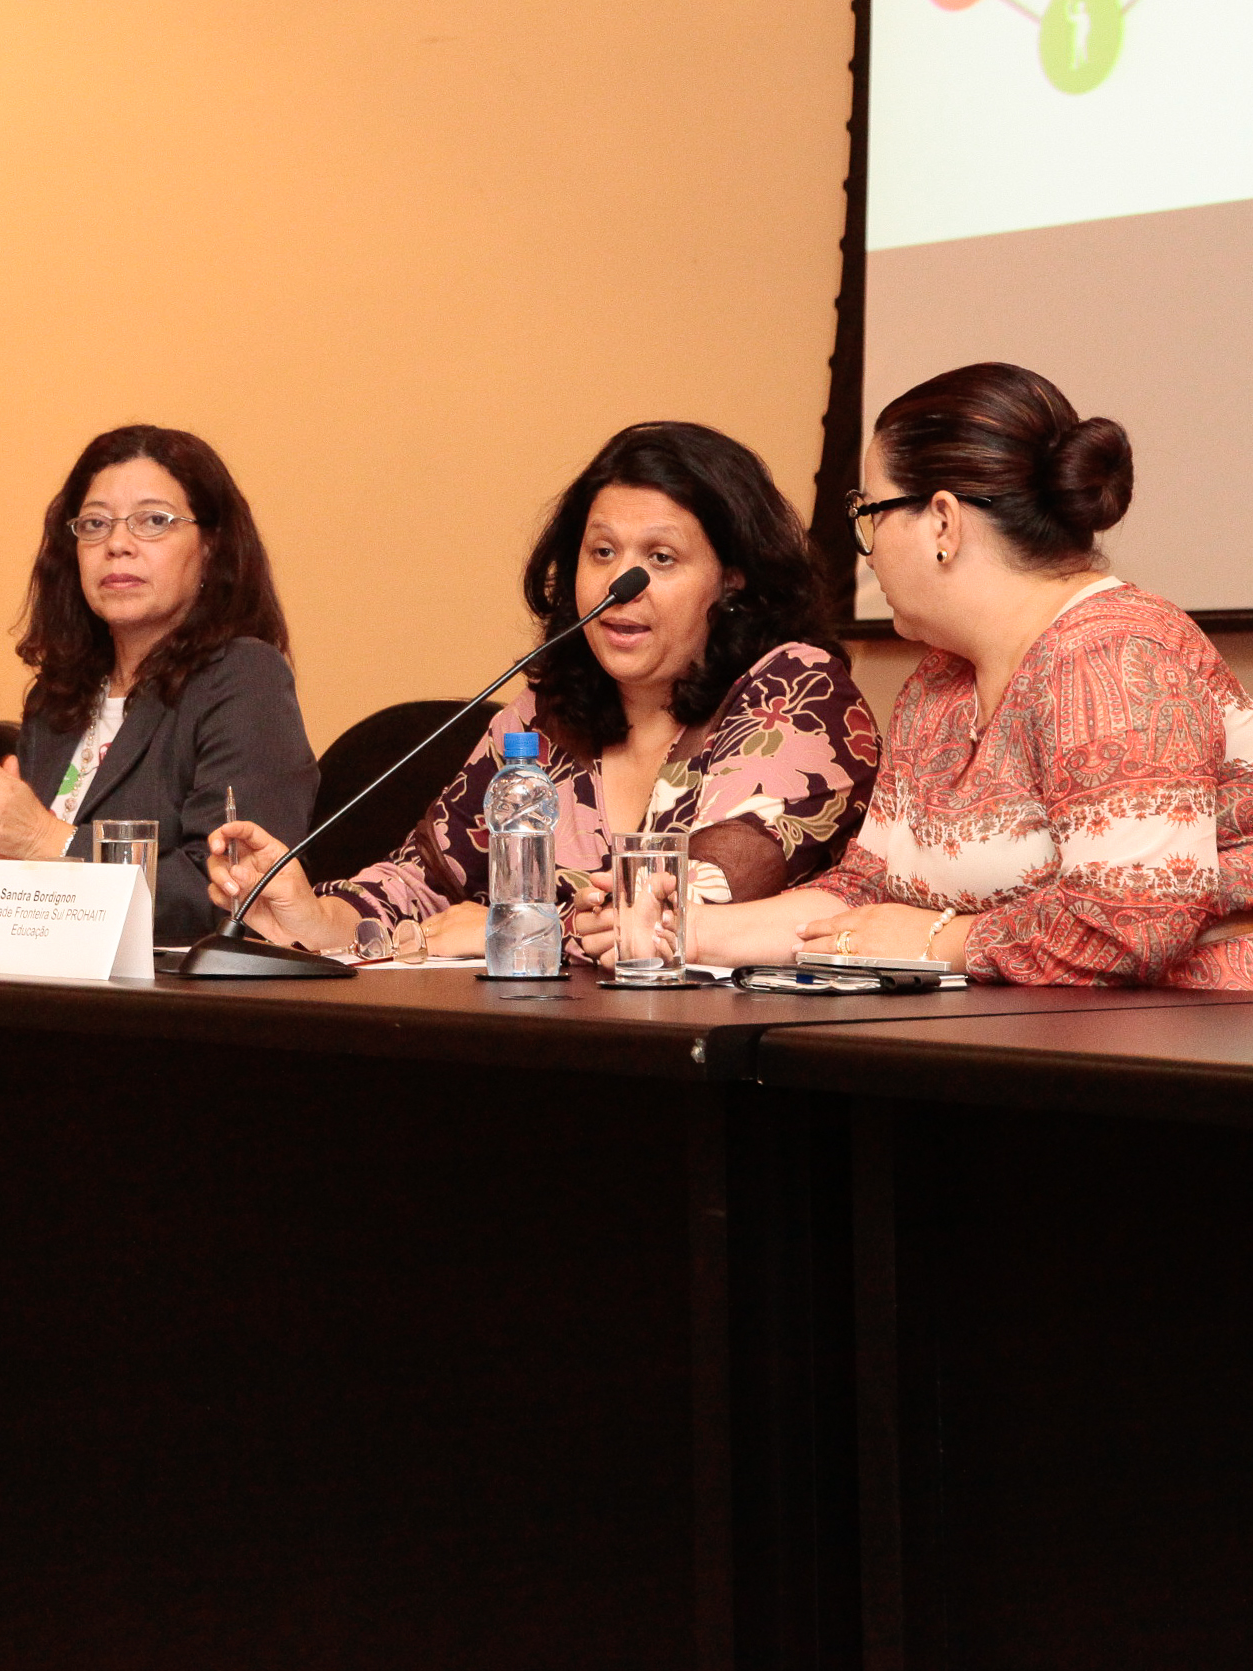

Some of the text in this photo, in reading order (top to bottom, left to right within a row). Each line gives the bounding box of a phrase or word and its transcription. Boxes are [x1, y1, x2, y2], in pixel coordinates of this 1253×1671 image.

[0, 888, 77, 906] Sandra Bordignon
[14, 906, 50, 920] Fronteira
[51, 908, 64, 921] Sul
[65, 908, 107, 922] PROHAITI
[10, 923, 50, 939] Educação
